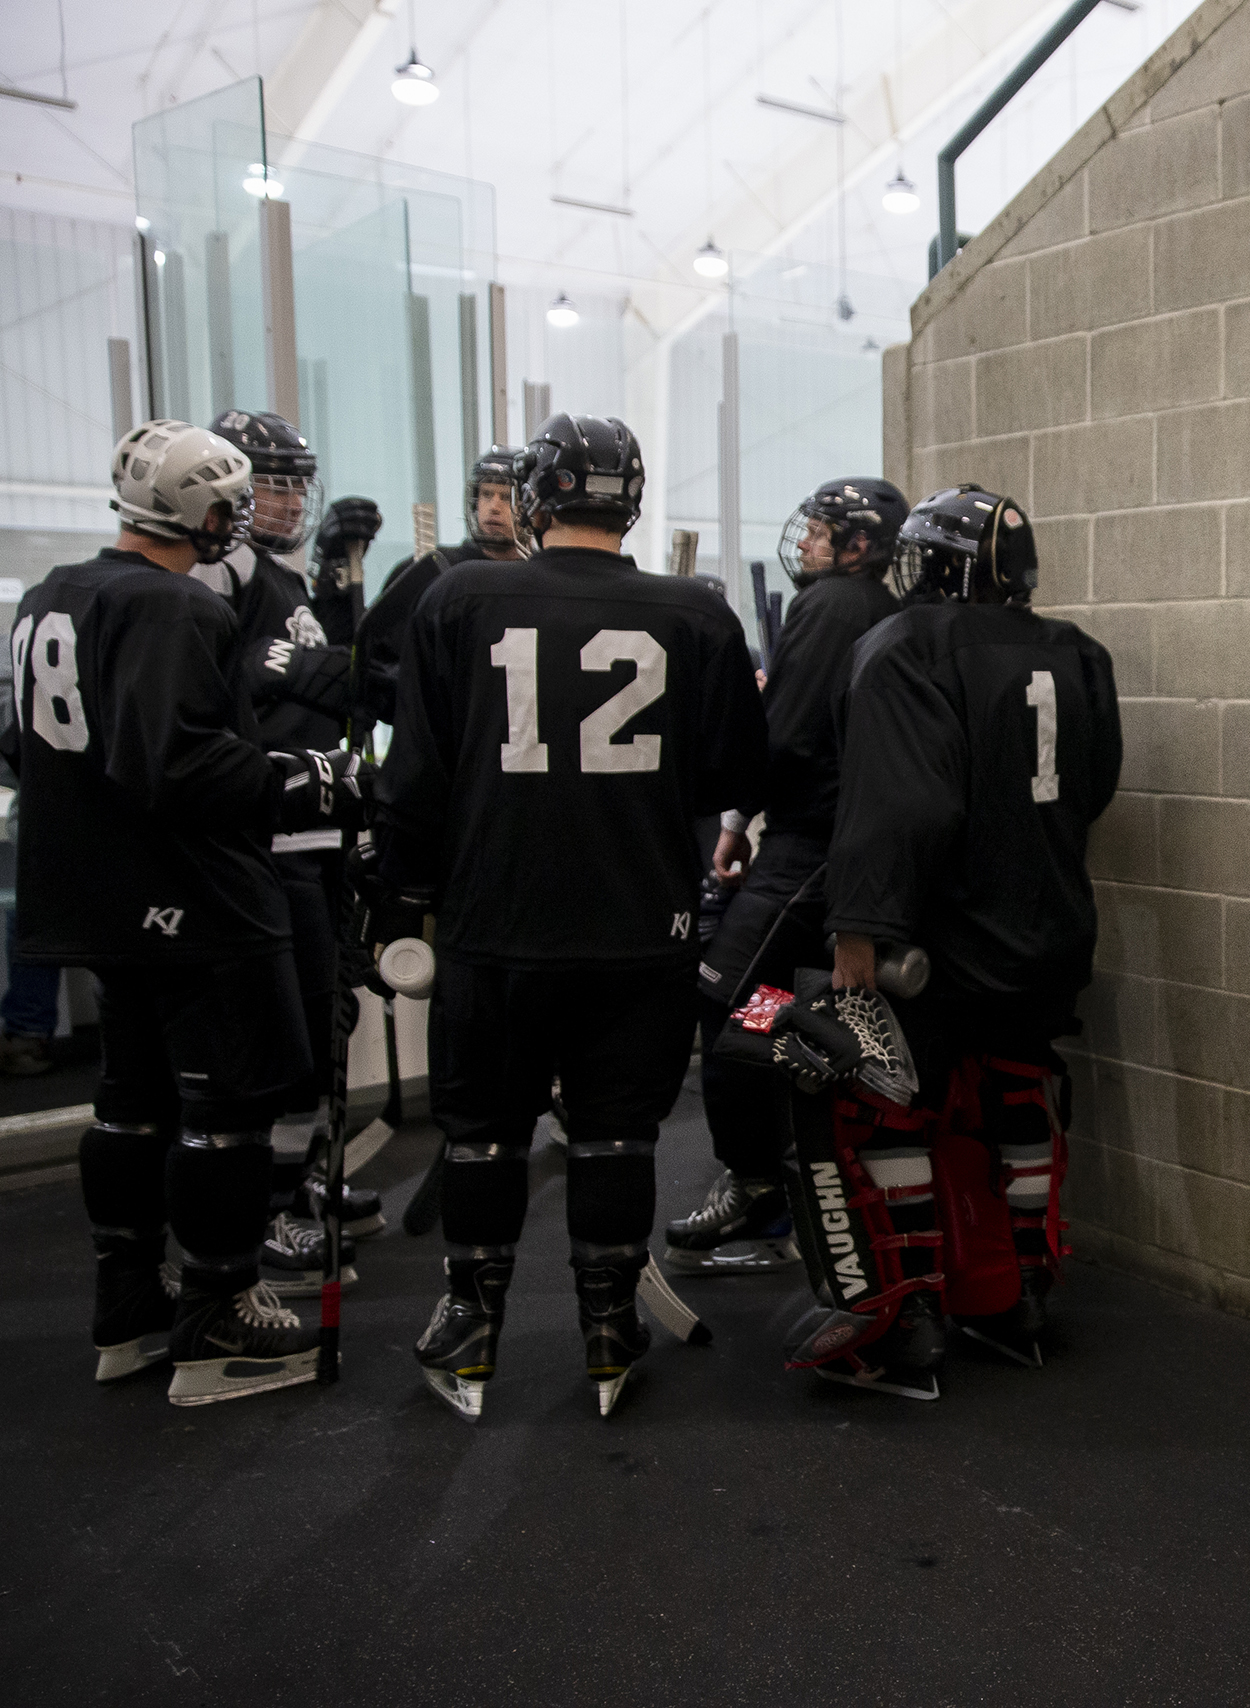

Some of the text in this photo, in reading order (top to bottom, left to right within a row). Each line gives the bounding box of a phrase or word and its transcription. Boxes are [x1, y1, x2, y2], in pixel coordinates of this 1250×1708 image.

[489, 626, 668, 774] 12
[1025, 669, 1060, 804] 1
[305, 749, 334, 817] CC
[809, 1161, 869, 1300] VAUGHN
